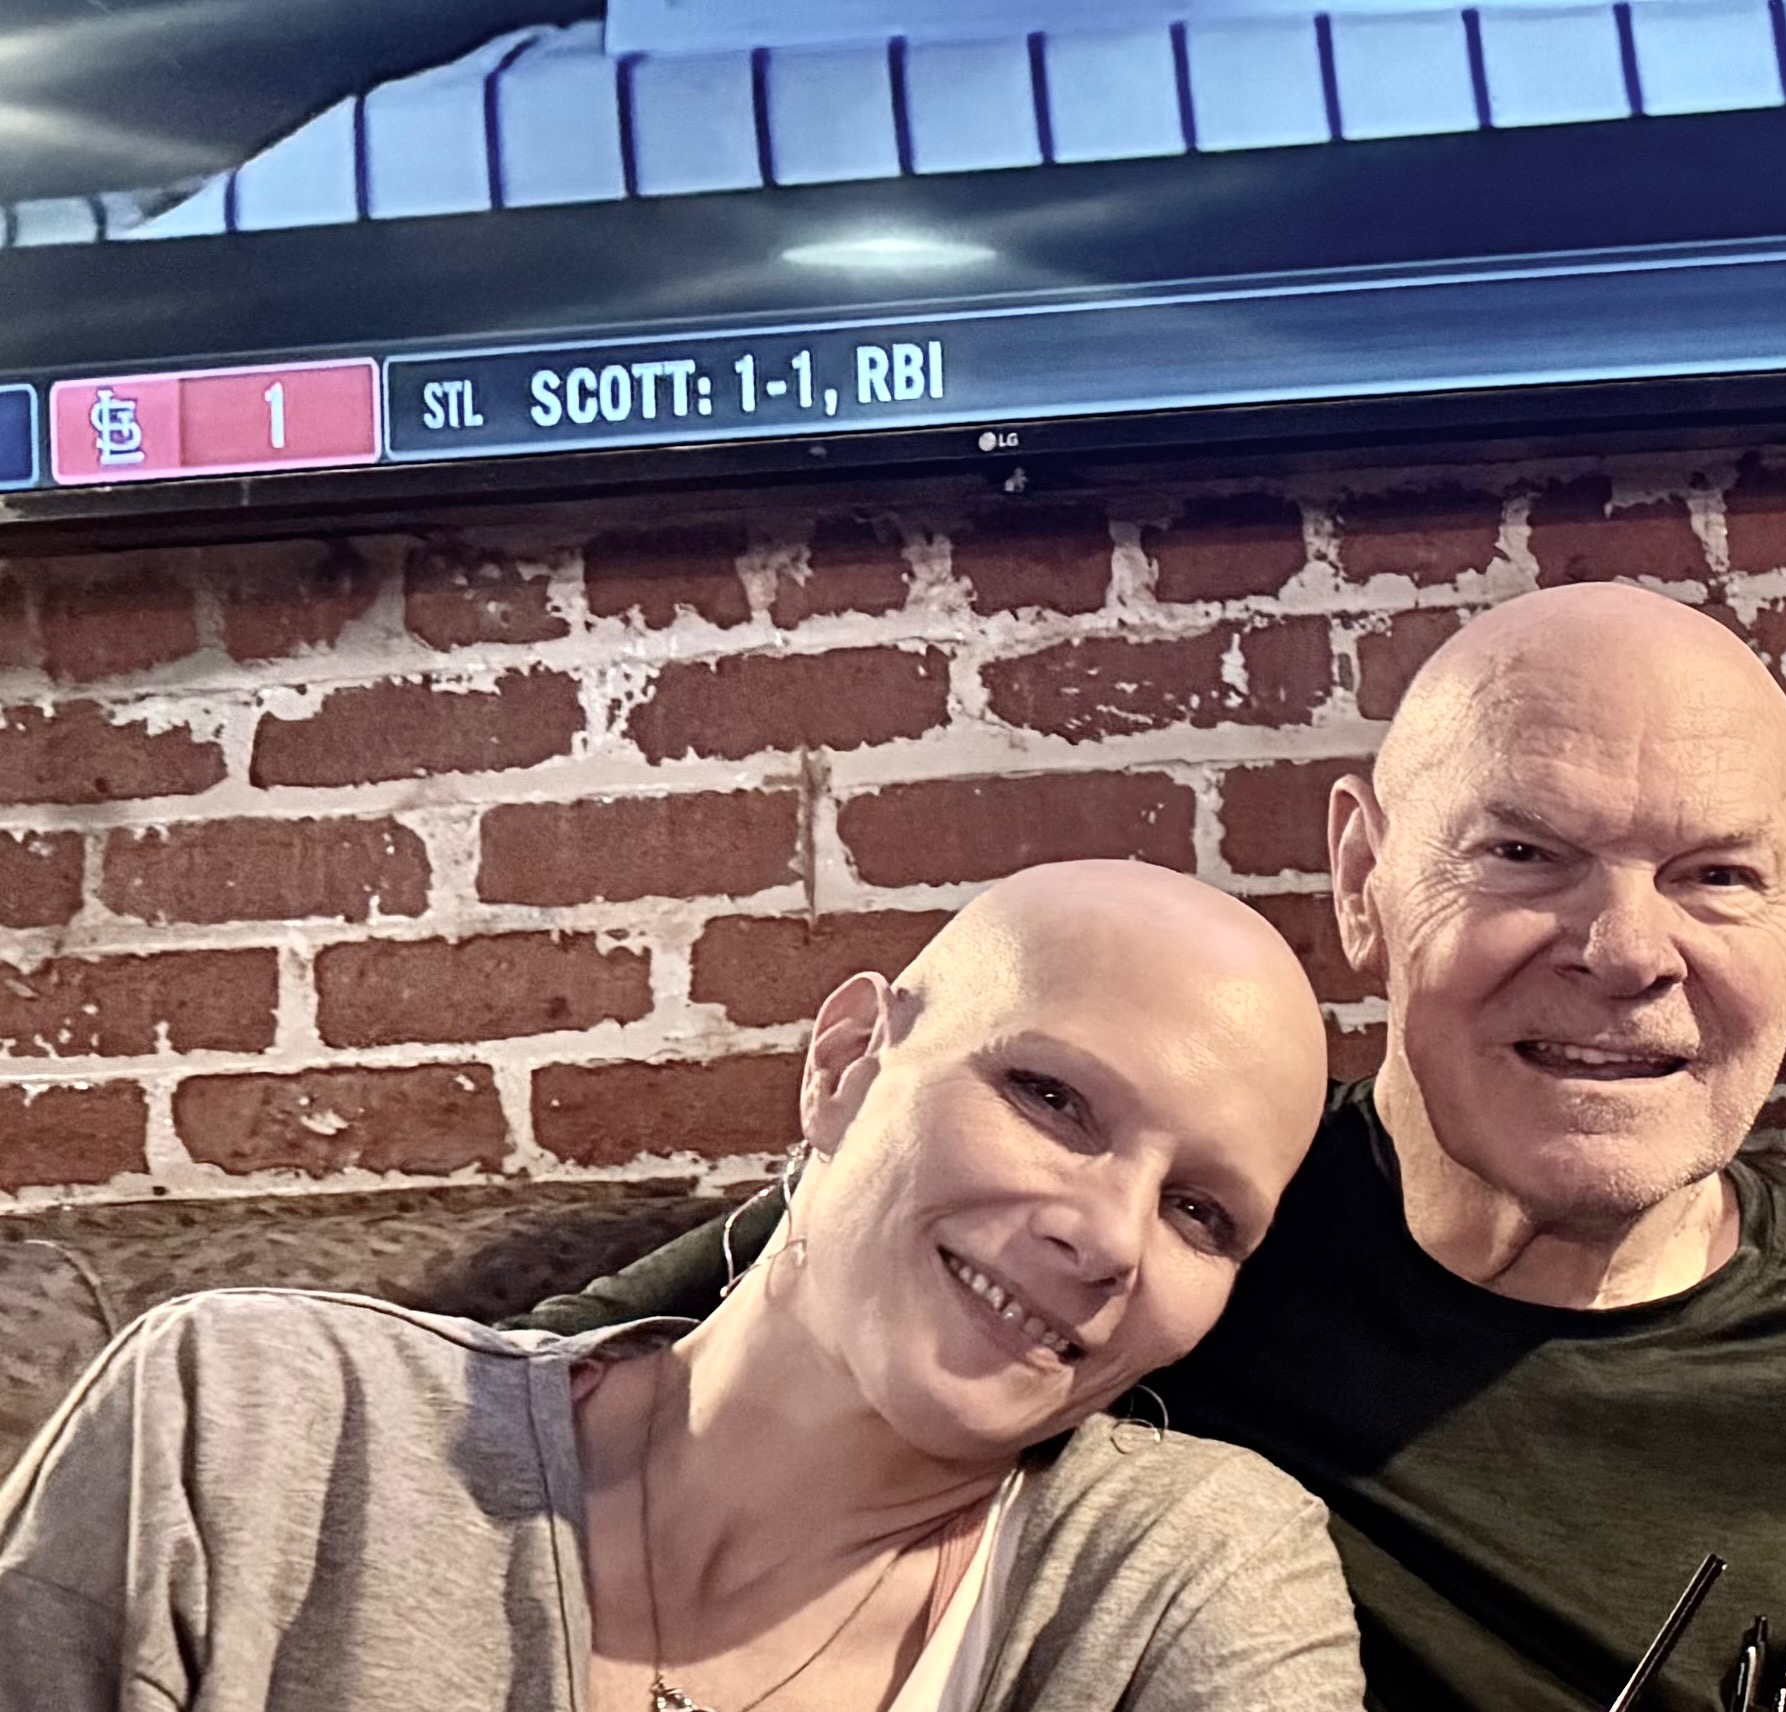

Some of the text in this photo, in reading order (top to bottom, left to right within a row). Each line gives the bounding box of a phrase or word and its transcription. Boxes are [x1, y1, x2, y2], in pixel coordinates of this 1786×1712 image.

[263, 381, 285, 449] 1
[422, 340, 945, 431] STL SCOTT: 1-1, RBI
[998, 431, 1020, 448] LG
